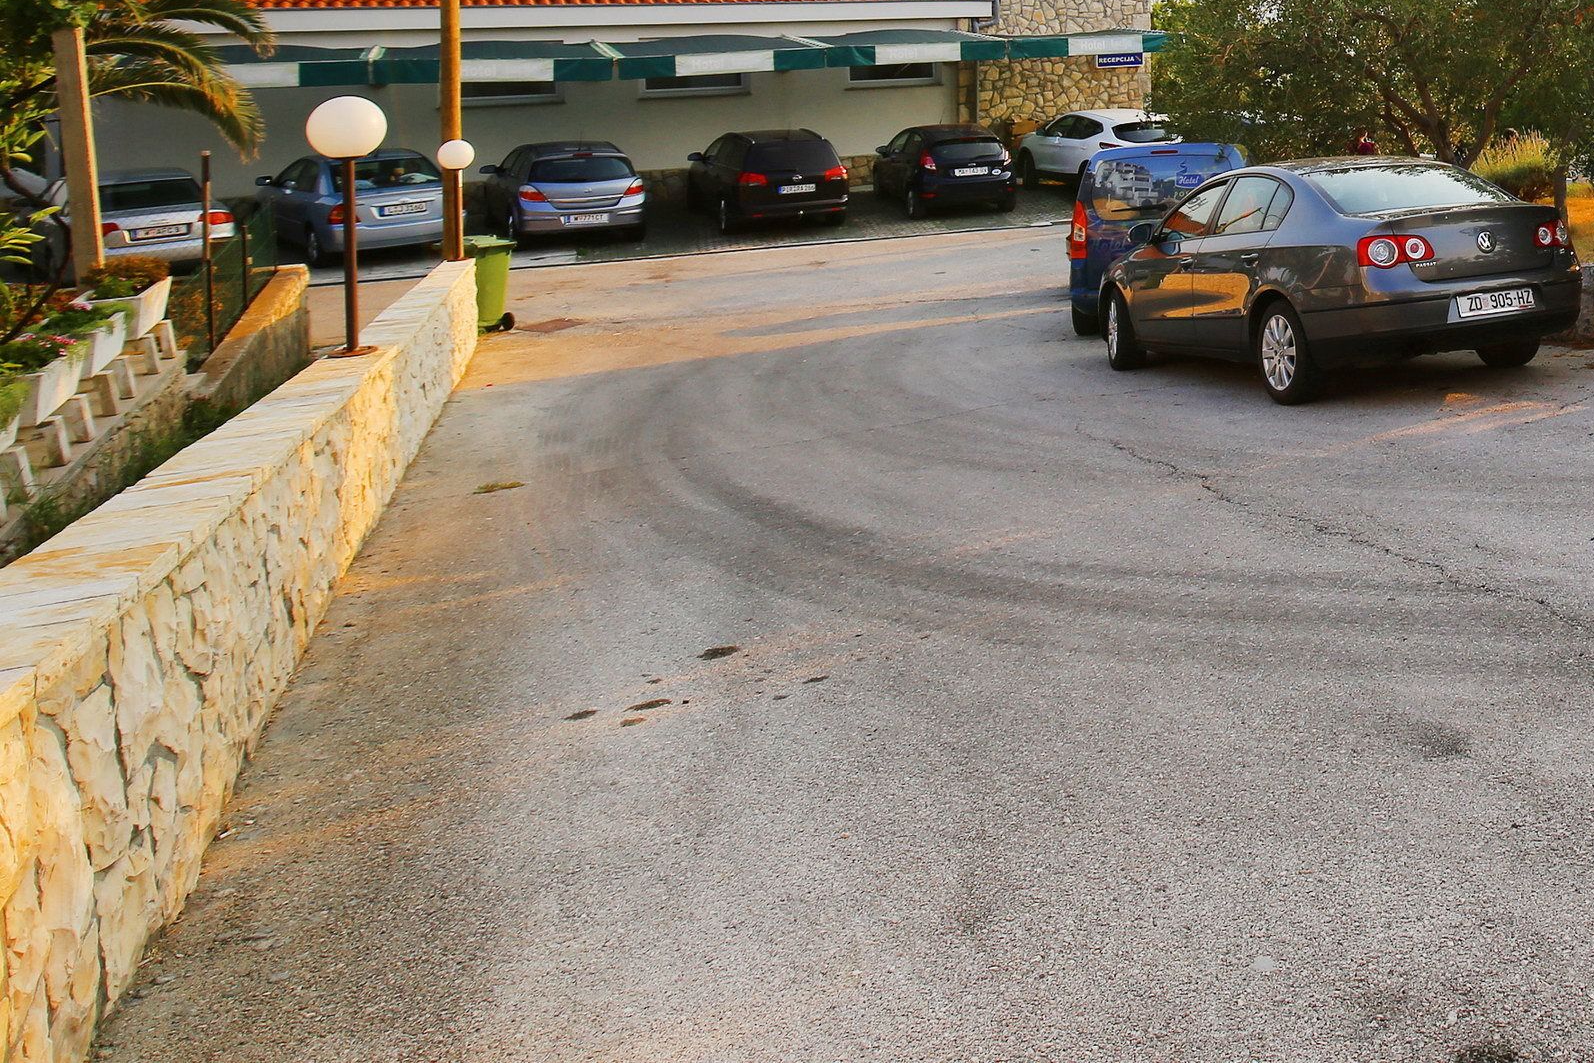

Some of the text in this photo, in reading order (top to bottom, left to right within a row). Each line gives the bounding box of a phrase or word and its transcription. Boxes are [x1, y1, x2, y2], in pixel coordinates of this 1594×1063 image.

[1098, 56, 1135, 64] RECEPCIJA
[1178, 175, 1200, 185] Hotel
[1415, 261, 1437, 269] PASSAT
[1467, 290, 1533, 312] ZD 905-HZ
